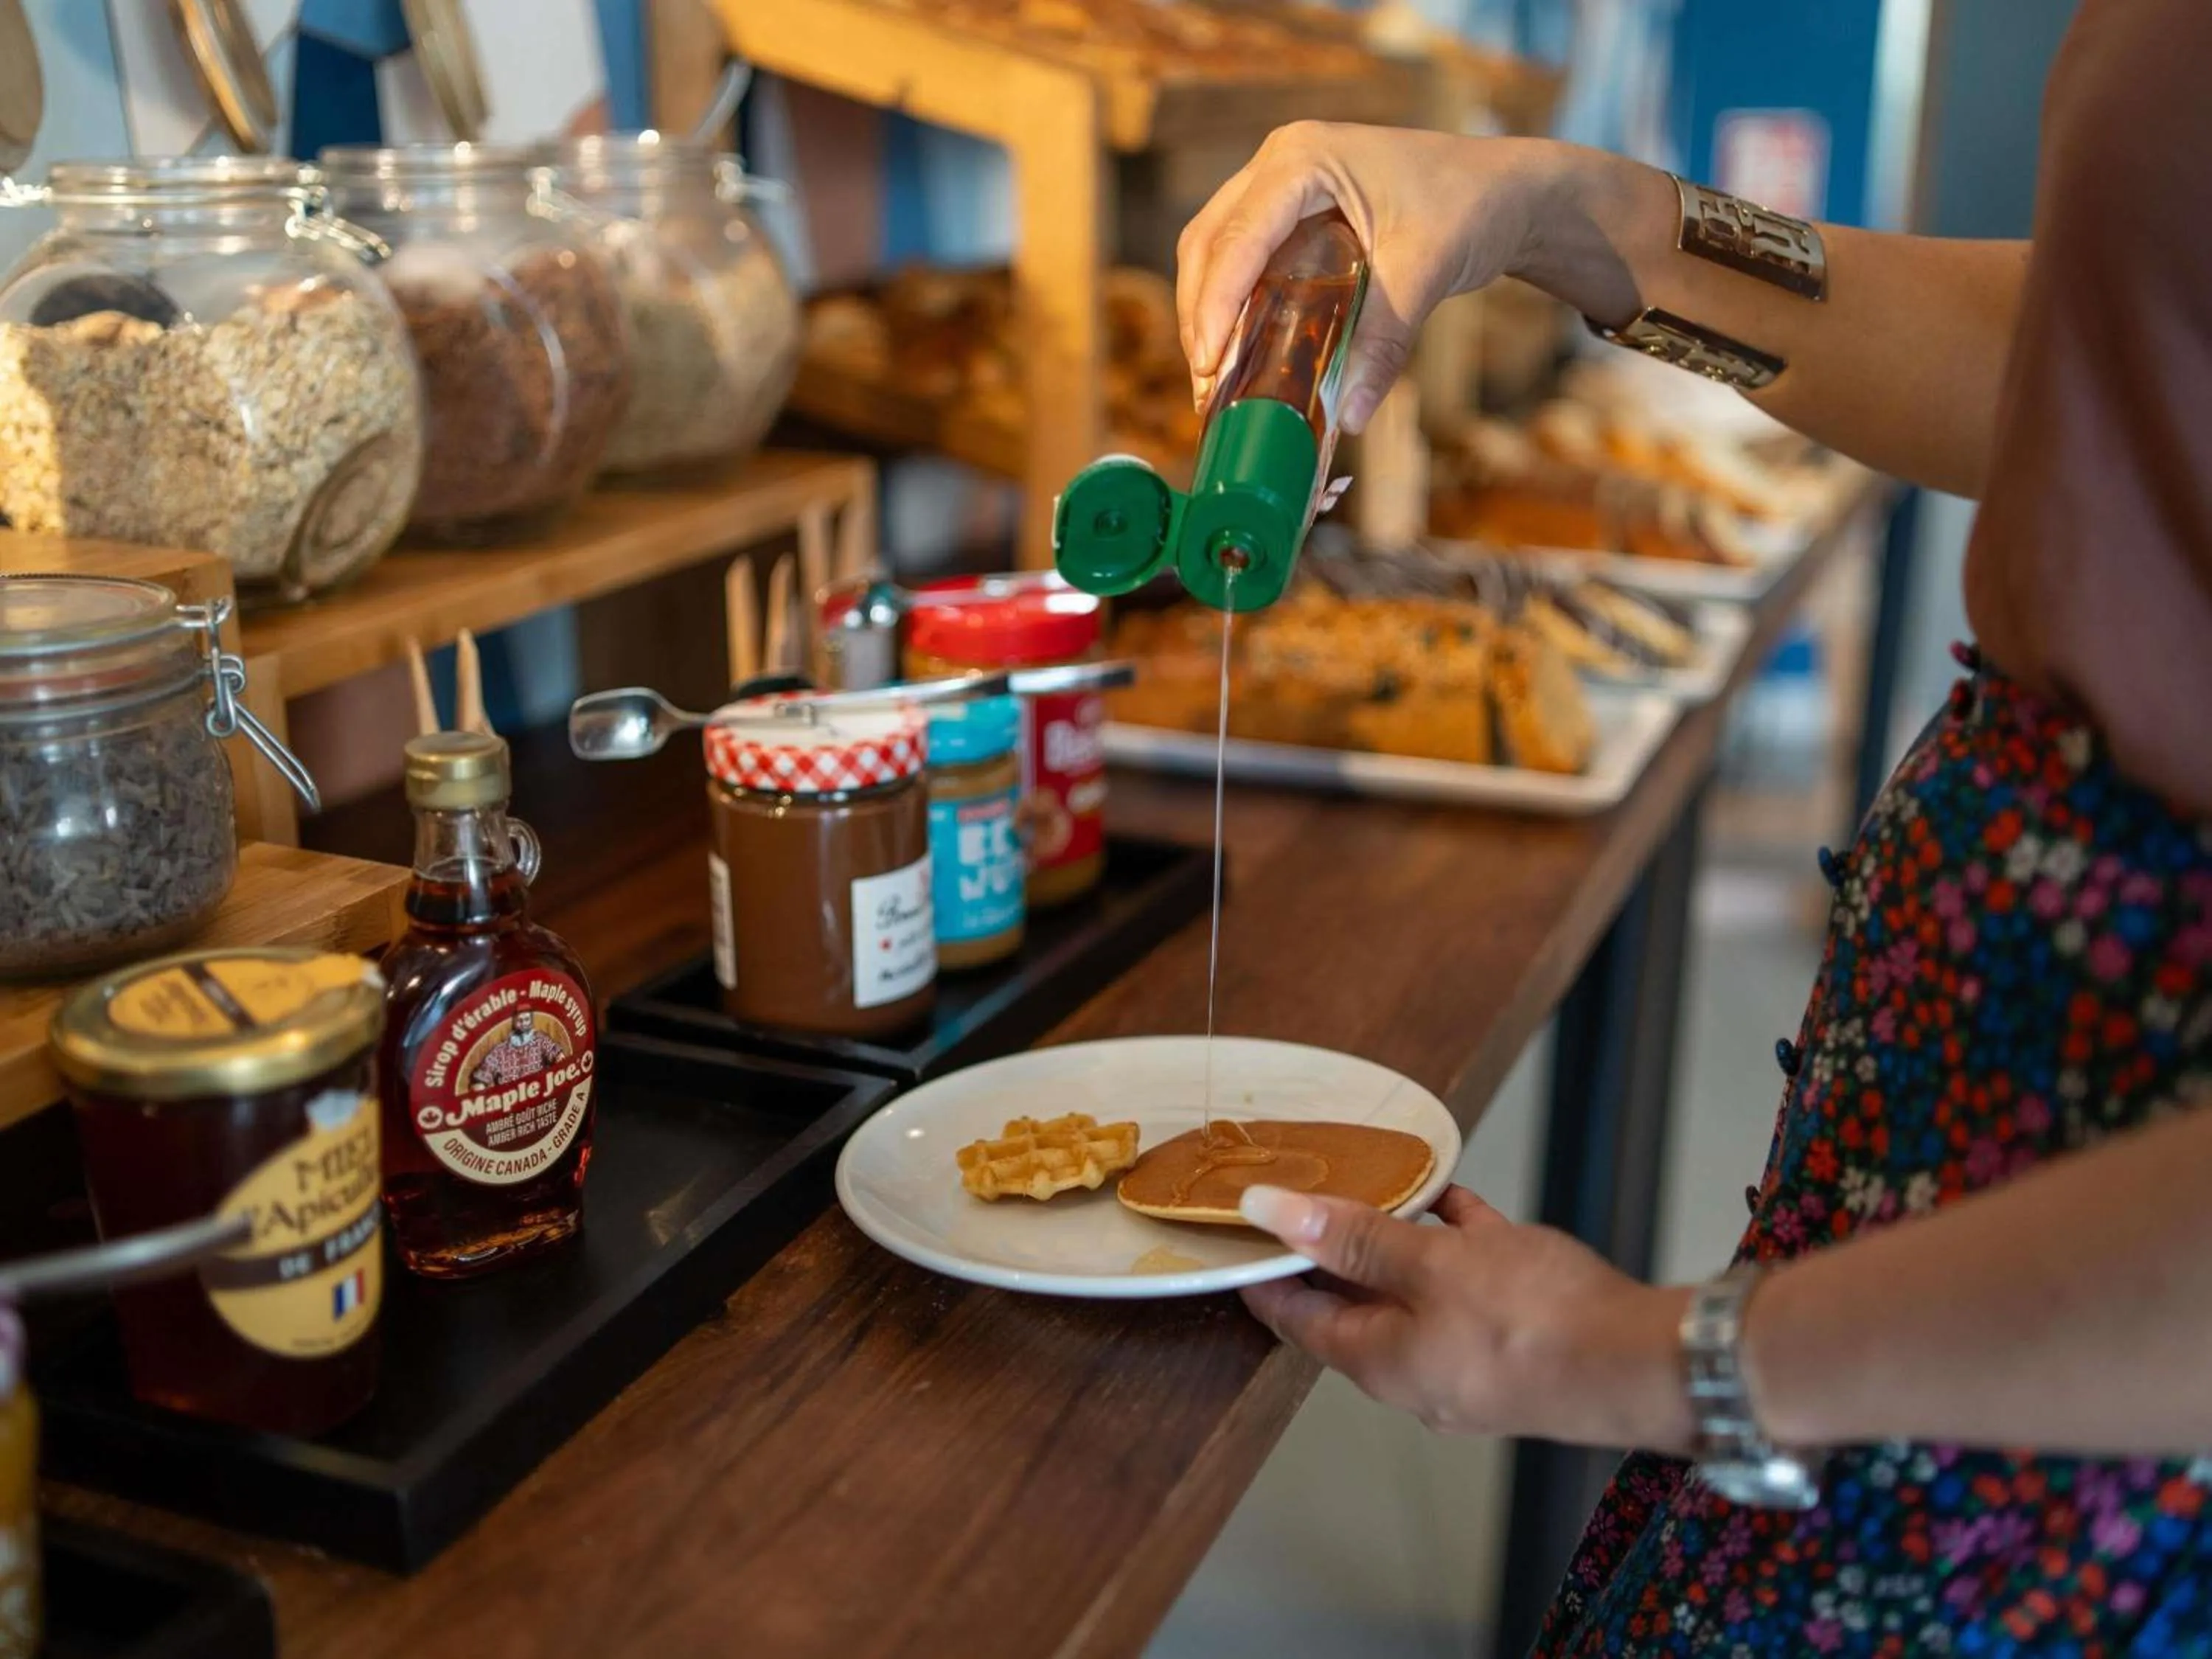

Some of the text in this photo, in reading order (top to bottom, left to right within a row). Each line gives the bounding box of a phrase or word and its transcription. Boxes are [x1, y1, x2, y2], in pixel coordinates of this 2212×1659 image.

[424, 1040, 459, 1088] Sirop
[451, 989, 517, 1041] d'érable
[529, 980, 567, 1004] Maple
[564, 997, 587, 1037] syrup
[445, 1062, 581, 1127] Maple Joe
[487, 1110, 558, 1147] AMBER RICH TASTE
[444, 1138, 495, 1175] ORIGINE
[495, 1147, 548, 1175] CANADA
[553, 1106, 580, 1149] GRADE
[576, 1091, 586, 1102] A
